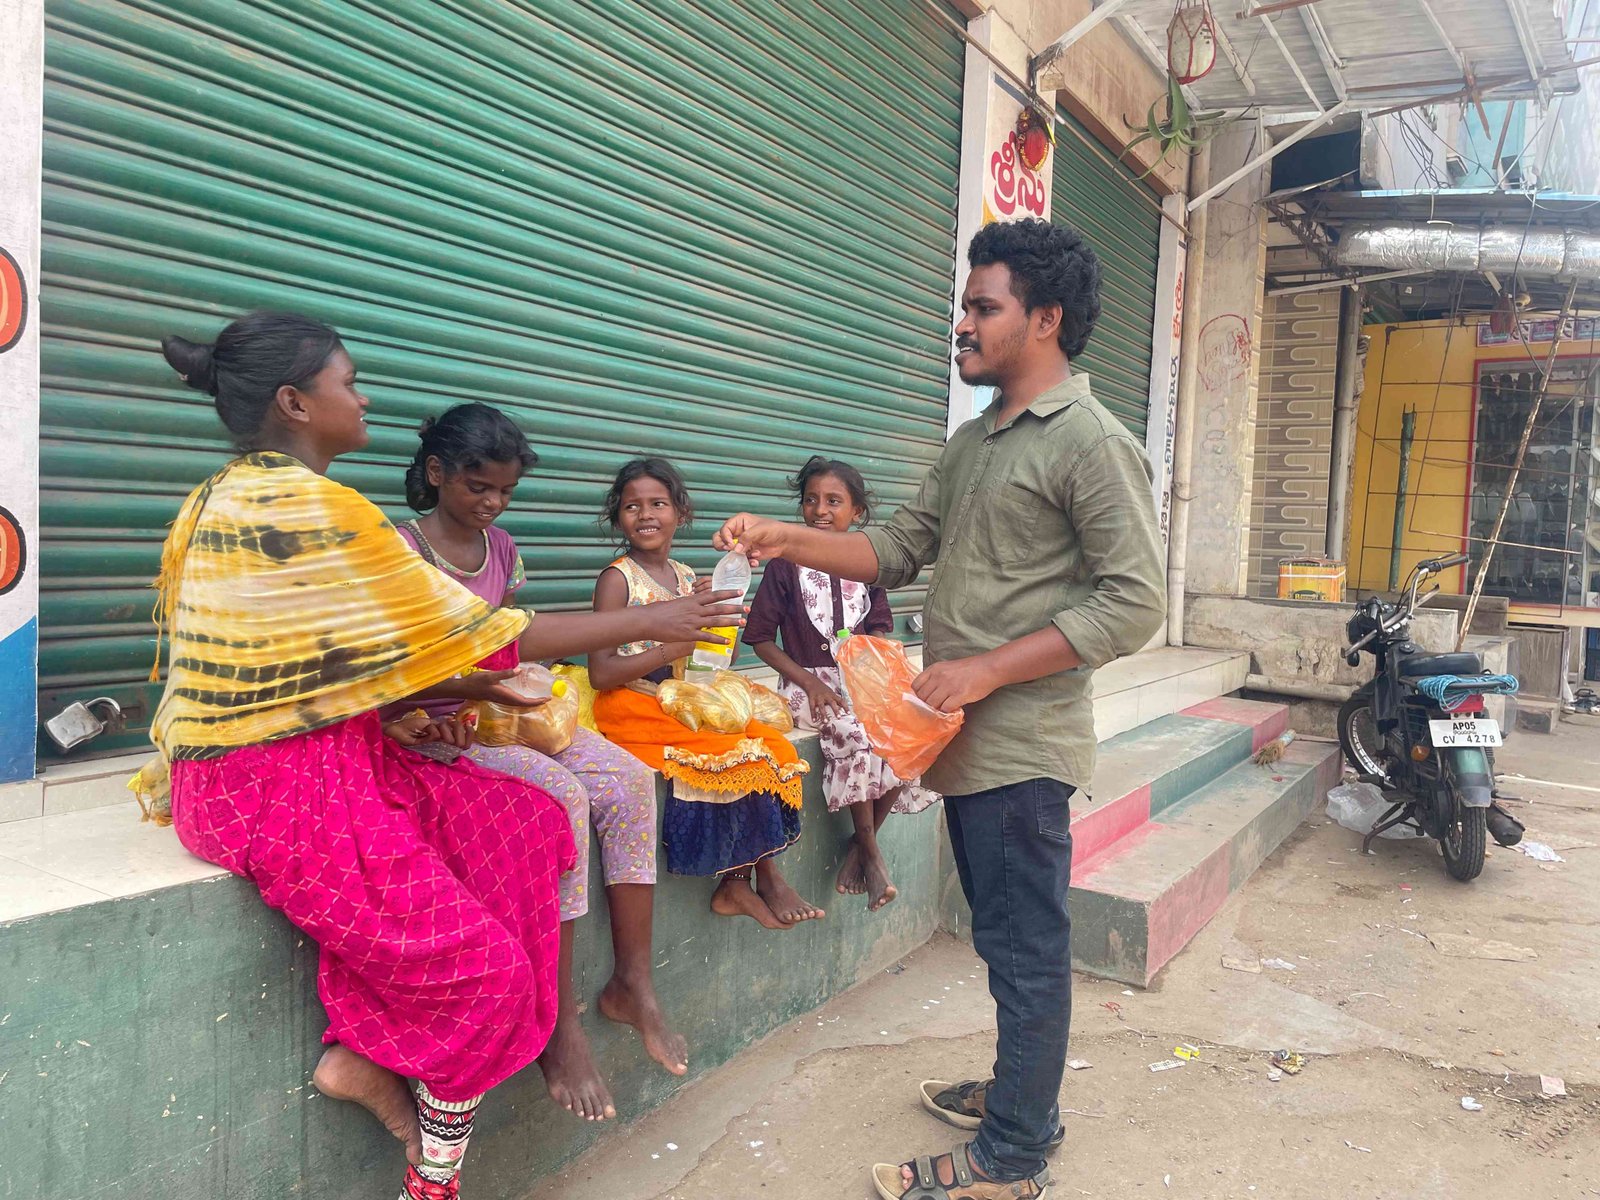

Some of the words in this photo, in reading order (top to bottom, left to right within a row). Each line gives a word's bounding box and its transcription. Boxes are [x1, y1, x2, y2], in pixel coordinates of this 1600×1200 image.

[1453, 721, 1476, 730] AP05
[1442, 735, 1455, 744] CV
[1467, 734, 1496, 743] 4278
